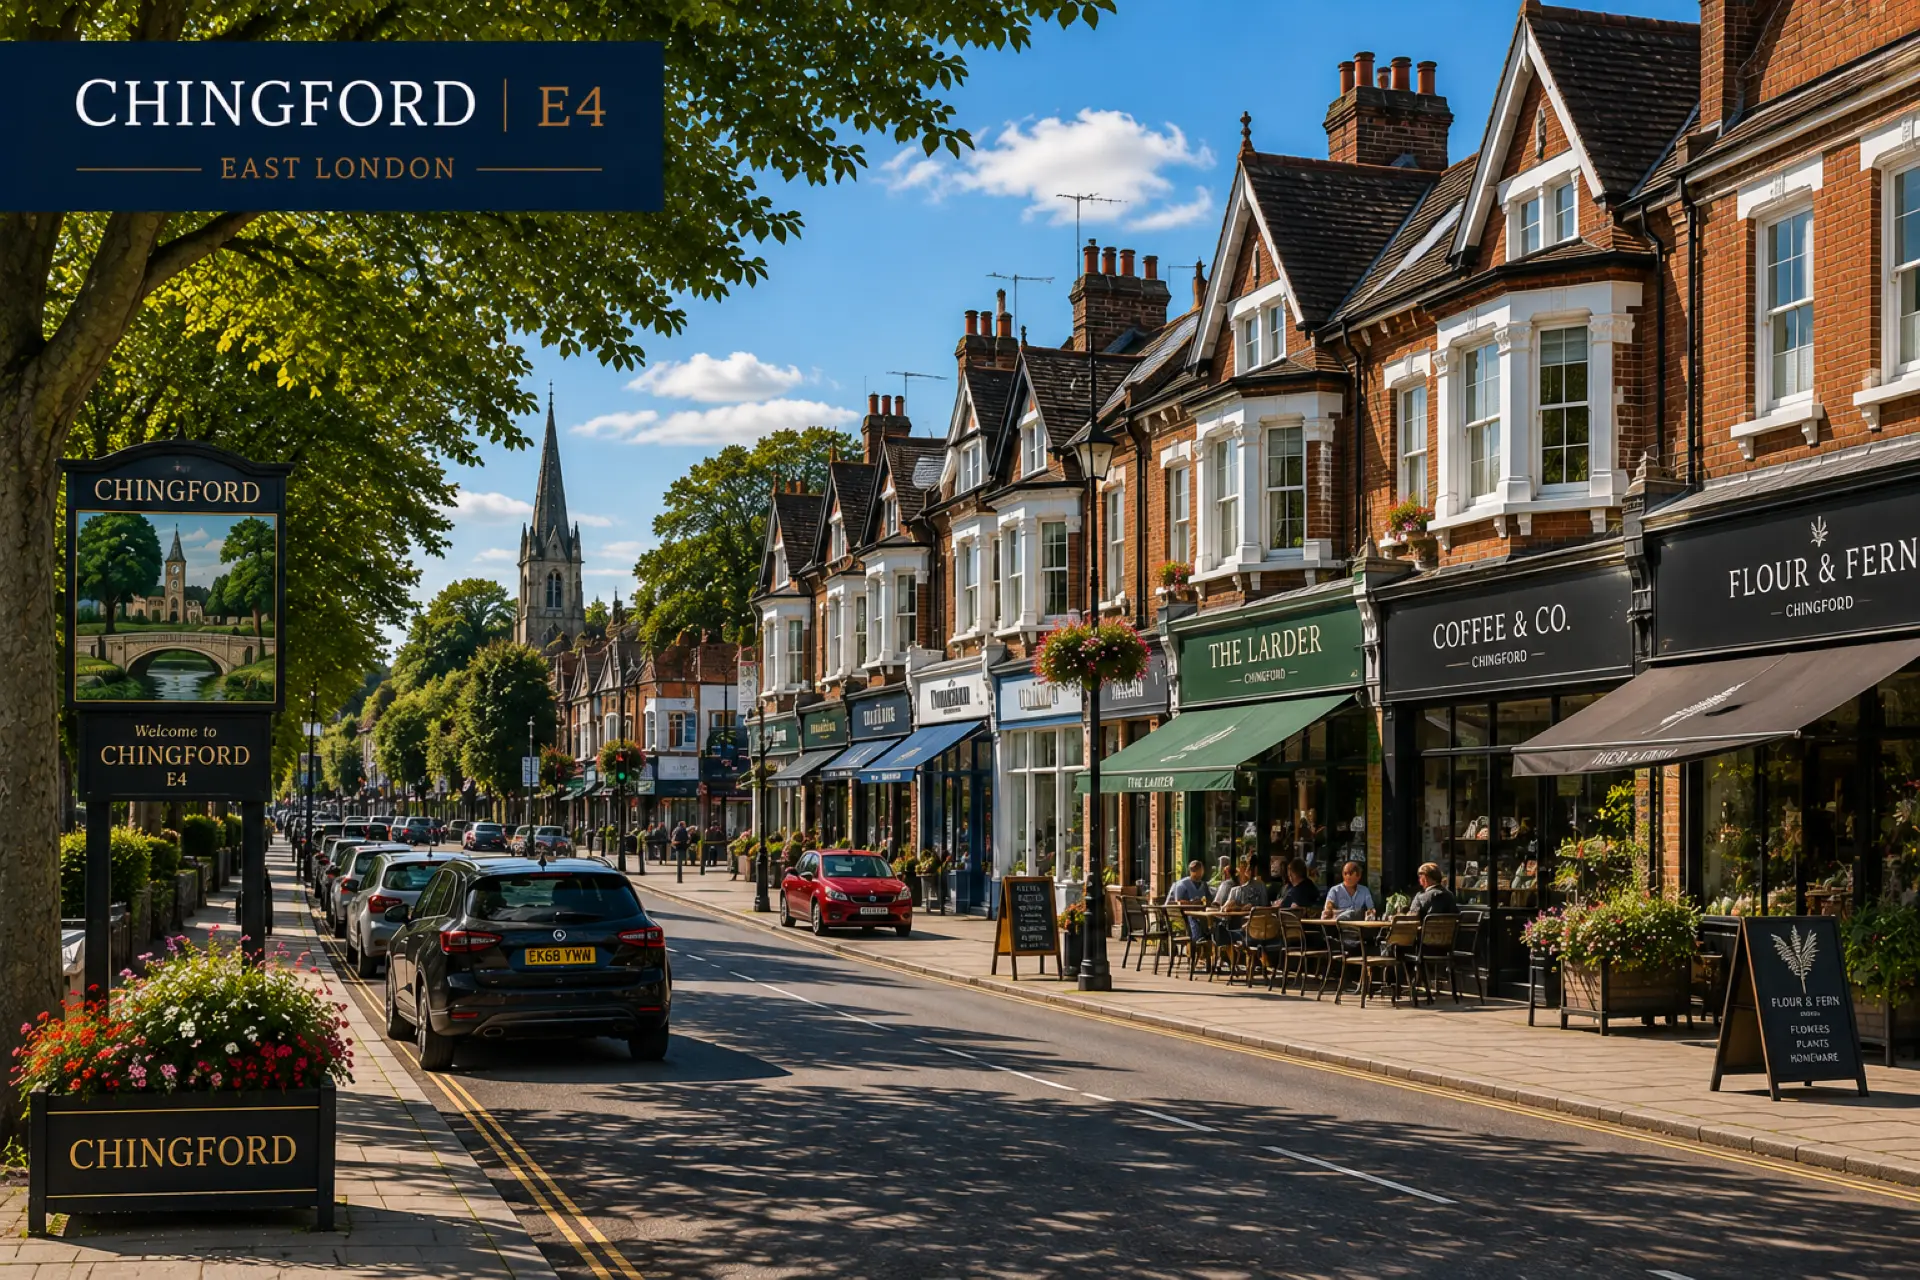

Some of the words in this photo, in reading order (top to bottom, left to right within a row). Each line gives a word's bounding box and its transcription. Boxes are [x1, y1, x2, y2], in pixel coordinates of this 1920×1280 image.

[94, 478, 261, 504] CHINGFORD
[1729, 557, 1810, 599] FLOUR
[1818, 552, 1836, 584] &
[1845, 536, 1918, 580] FERN
[1785, 595, 1854, 618] CHINGFORD
[1432, 612, 1507, 650] COFFEE
[1513, 610, 1528, 638] &
[1535, 603, 1571, 635] CO.
[1208, 638, 1242, 669] THE
[1247, 624, 1323, 663] LARDER
[1471, 649, 1527, 669] CHINGFORD
[135, 724, 198, 738] Welcome
[204, 725, 217, 738] to
[100, 745, 250, 766] CHINGFORD
[166, 771, 188, 787] E4
[529, 949, 561, 963] EK68
[564, 948, 591, 962] YWN
[1771, 996, 1803, 1008] FLOUR
[1805, 996, 1813, 1007] &
[1815, 995, 1841, 1007] FERN
[69, 1134, 298, 1170] CHINGFORD
